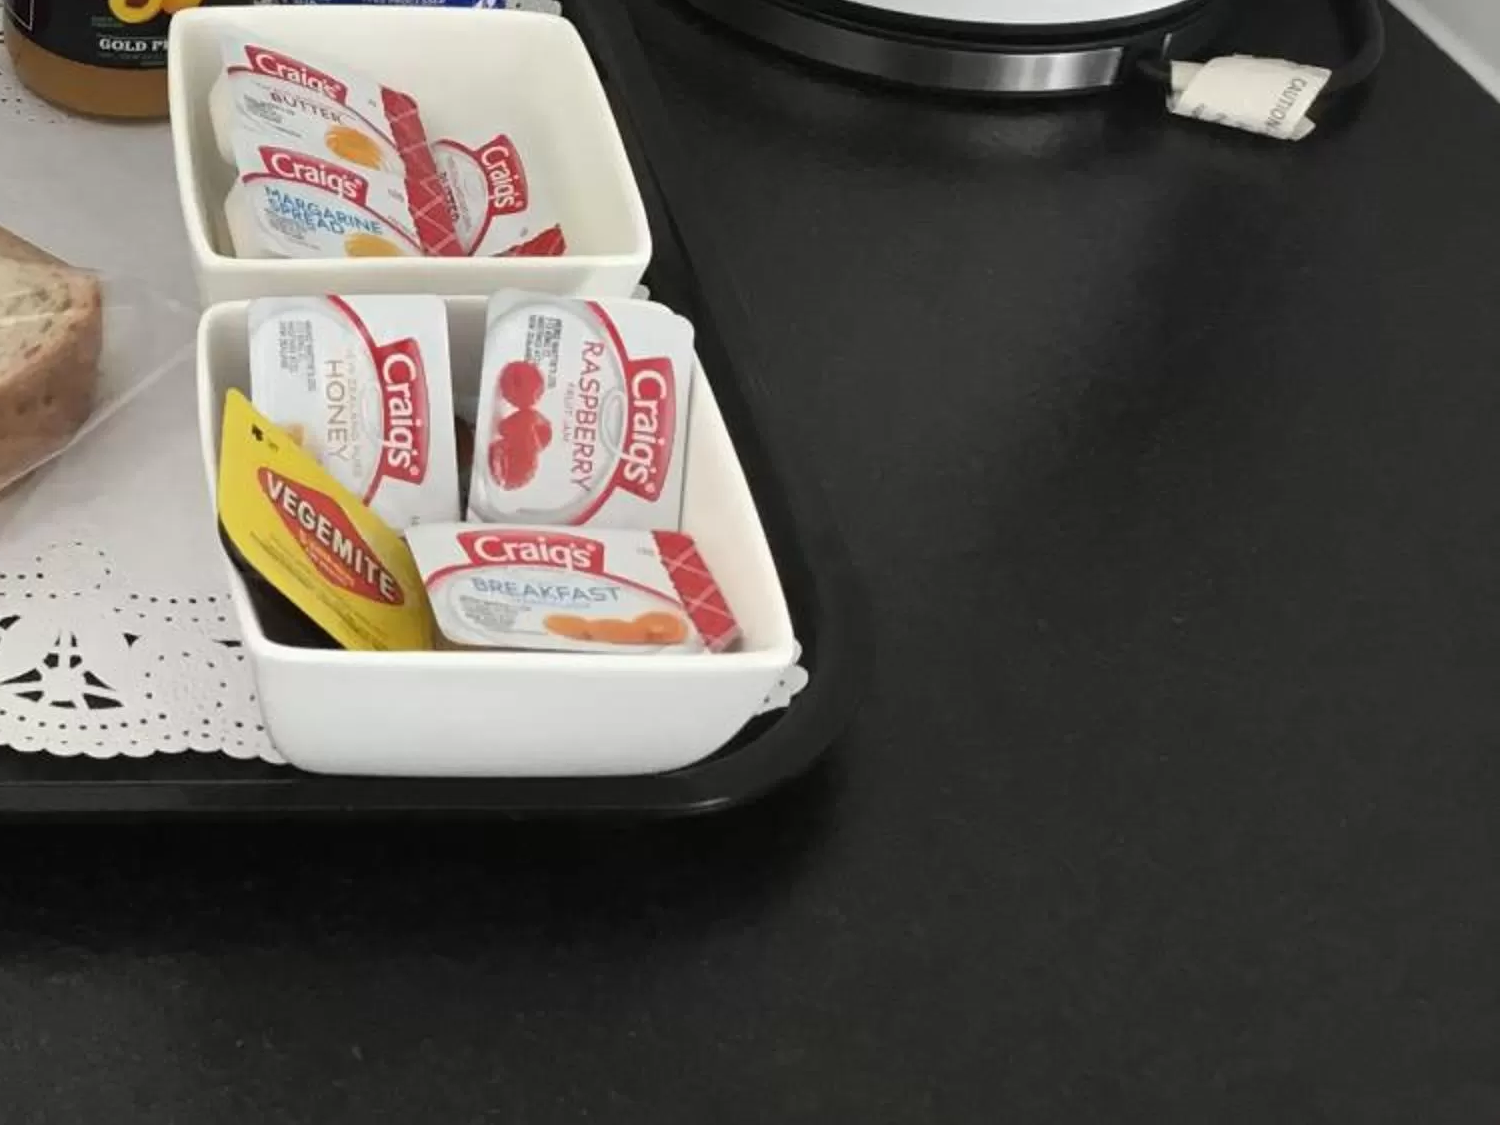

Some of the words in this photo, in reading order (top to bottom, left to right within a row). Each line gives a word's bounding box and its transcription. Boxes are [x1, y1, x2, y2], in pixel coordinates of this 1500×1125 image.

[99, 38, 148, 52] GOLD
[255, 53, 343, 100] Craig's
[269, 89, 343, 124] BUTTER
[1265, 77, 1309, 128] CAUTION
[270, 152, 363, 200] Craig's
[481, 144, 522, 209] Craig's
[264, 186, 382, 236] MARGARINE
[324, 359, 350, 463] HONEY
[382, 352, 422, 472] Craig's
[571, 340, 606, 493] RASPBERRY
[622, 369, 668, 487] Craig's
[266, 471, 397, 602] VEGEMITE
[474, 534, 596, 573] Craig's
[472, 577, 621, 603] BREAKFAST
